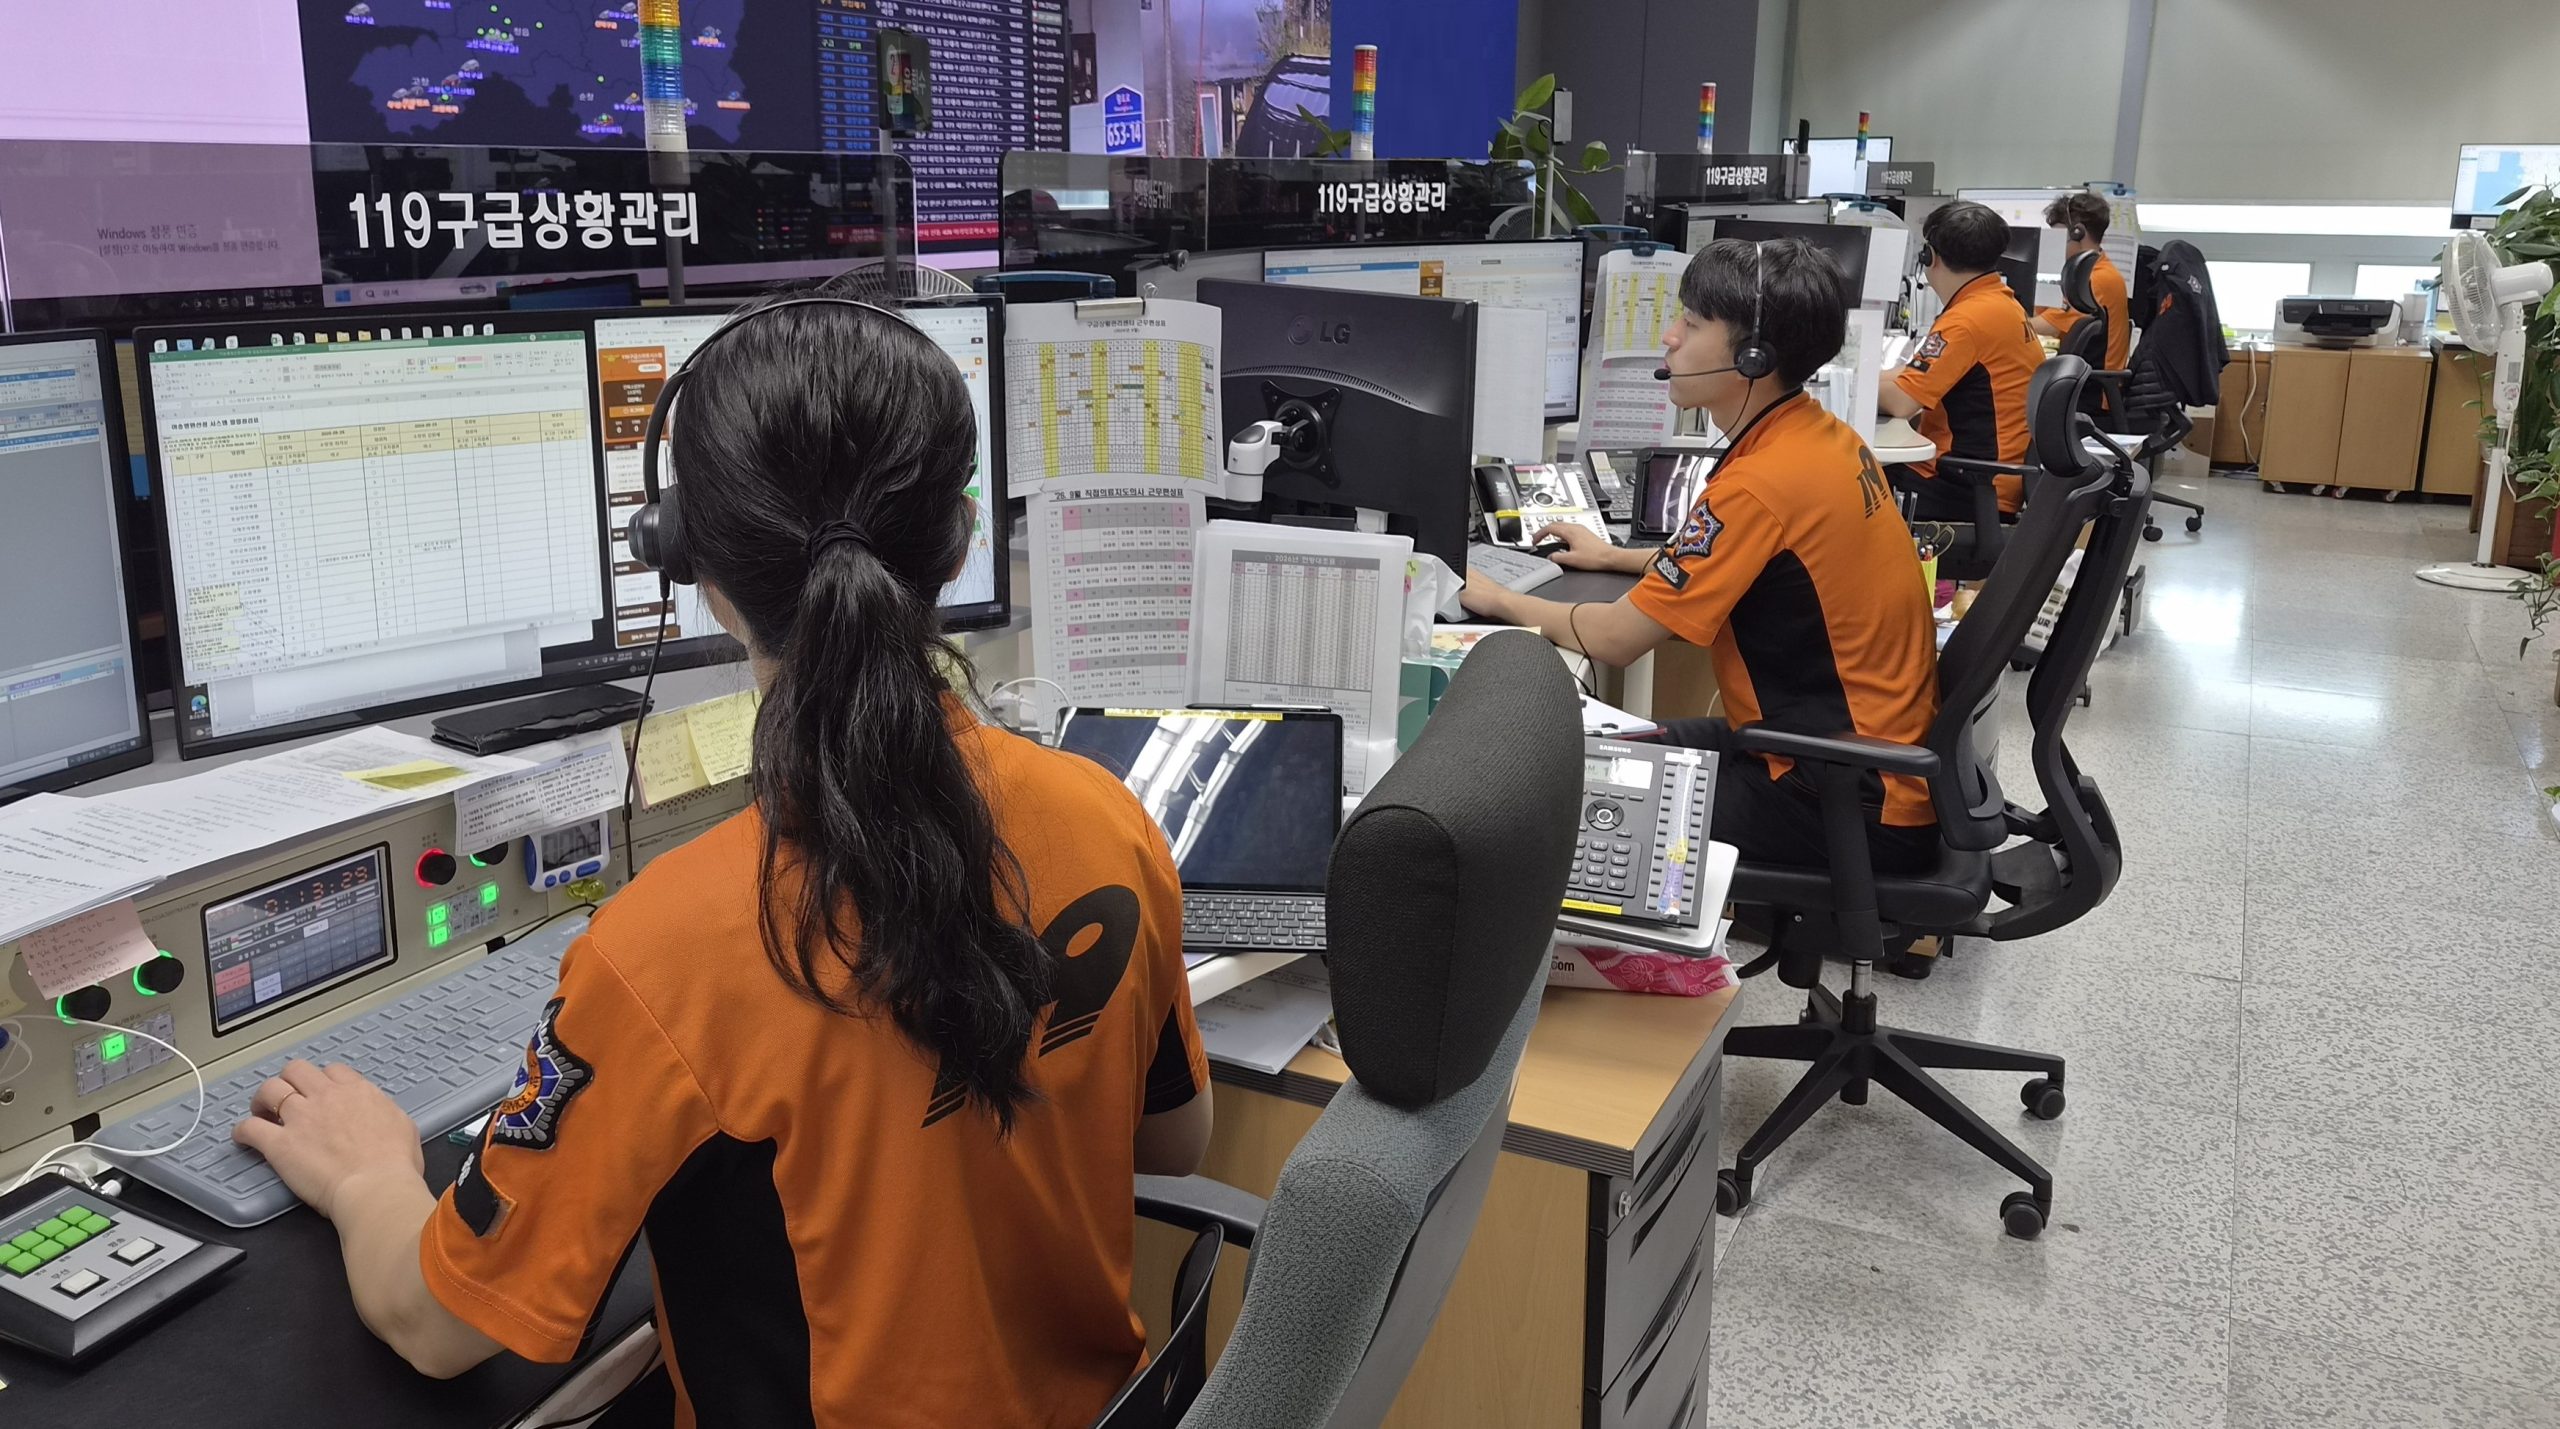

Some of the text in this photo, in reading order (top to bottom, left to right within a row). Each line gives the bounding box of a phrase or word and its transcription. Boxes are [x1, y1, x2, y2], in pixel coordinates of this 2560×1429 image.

[1107, 120, 1141, 147] 653-14
[1706, 166, 1768, 186] 119구급상황관리
[1318, 182, 1446, 214] 119구급상황관리
[349, 190, 699, 250] 119구급상황관리
[97, 227, 146, 240] Windows
[1320, 321, 1351, 344] LG
[1085, 488, 1144, 498] 직접의료지도의사
[1148, 488, 1183, 497] 근무편성표
[1275, 553, 1299, 564] 2026년
[1599, 744, 1632, 754] SAMSUNG
[1551, 961, 1575, 972] oom
[501, 1095, 530, 1113] ERVICE
